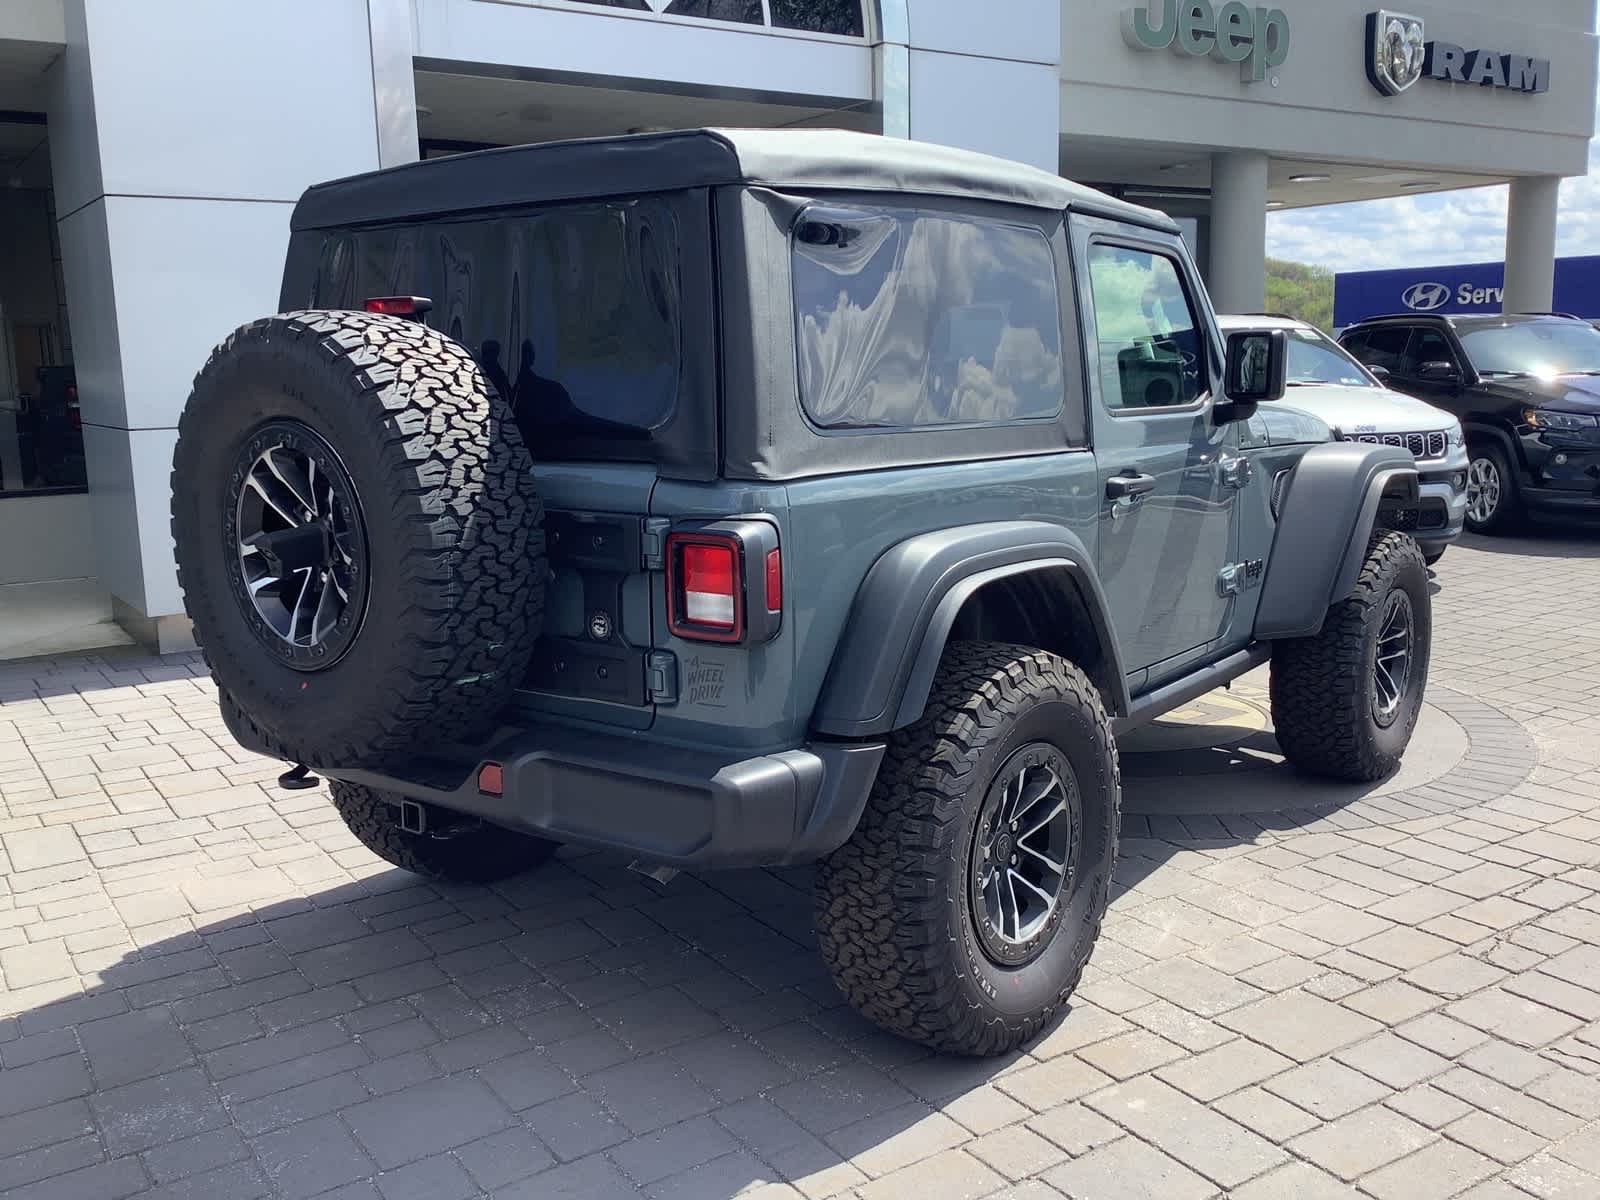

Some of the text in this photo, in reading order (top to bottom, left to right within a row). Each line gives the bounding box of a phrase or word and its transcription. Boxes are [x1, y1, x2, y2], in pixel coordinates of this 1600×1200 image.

[1122, 0, 1290, 83] Jeep
[1424, 41, 1550, 94] RAM
[1457, 283, 1504, 305] Serv
[688, 668, 725, 685] WHEEL
[689, 684, 725, 704] DRIVE
